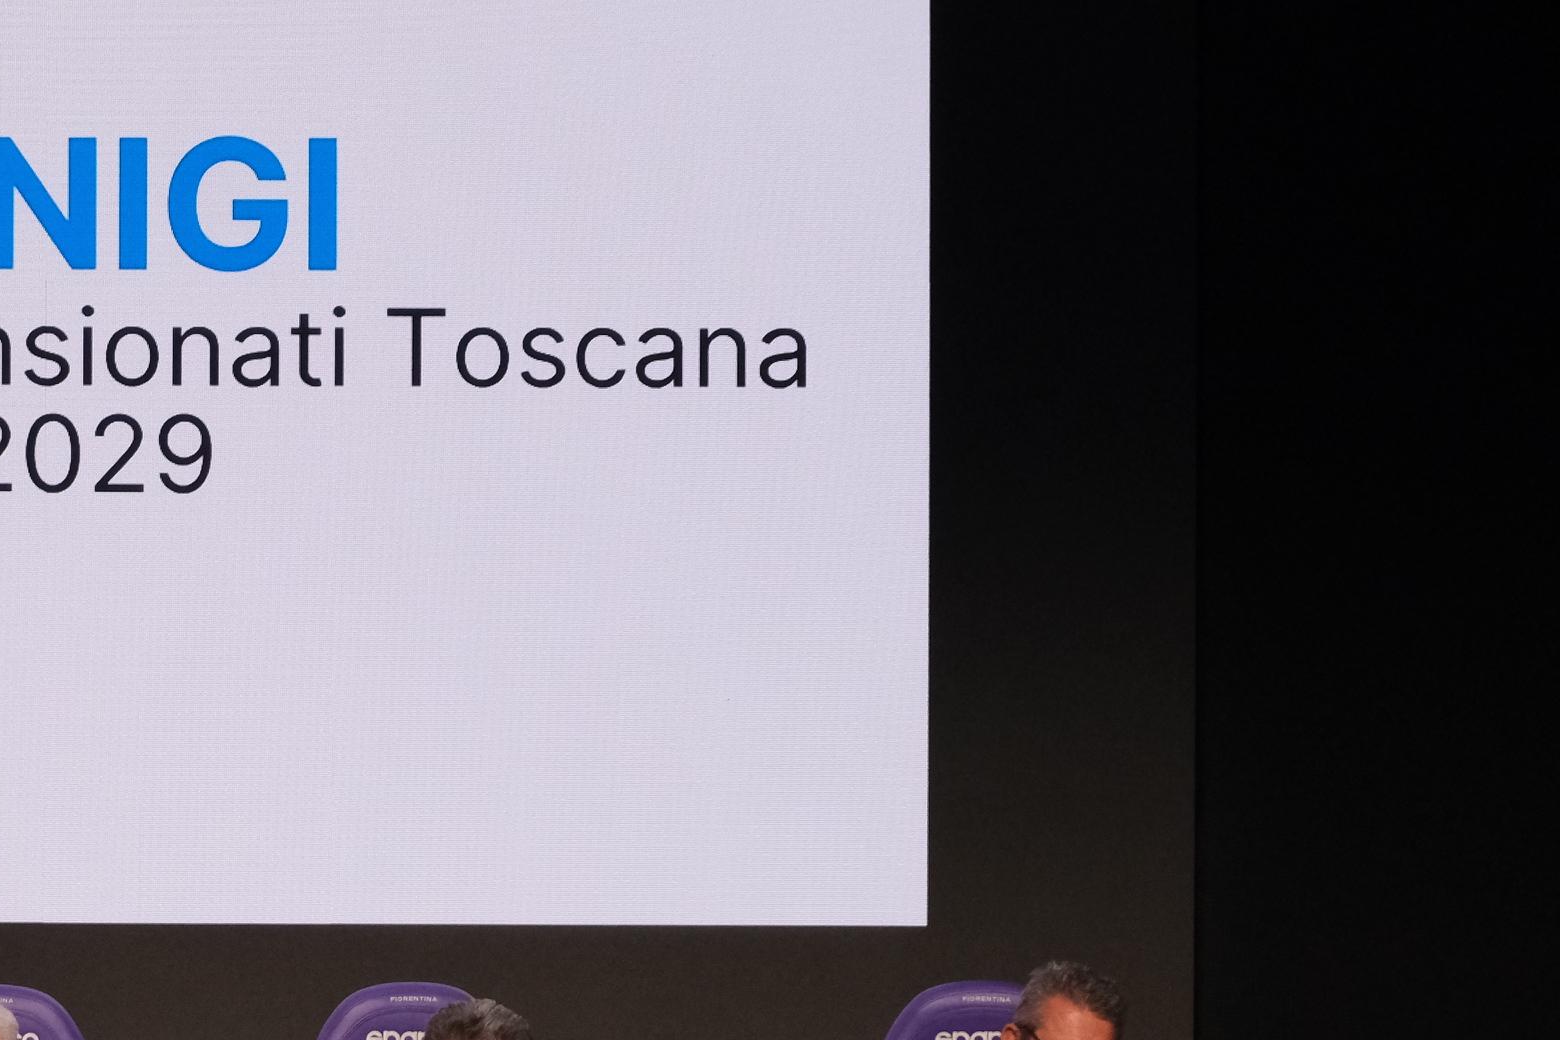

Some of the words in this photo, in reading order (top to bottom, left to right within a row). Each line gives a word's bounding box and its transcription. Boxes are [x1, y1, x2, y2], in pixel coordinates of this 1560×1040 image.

[387, 308, 806, 389] Toscana
[390, 995, 438, 1003] FIORENTINA
[962, 995, 1012, 1003] FIORENTINA
